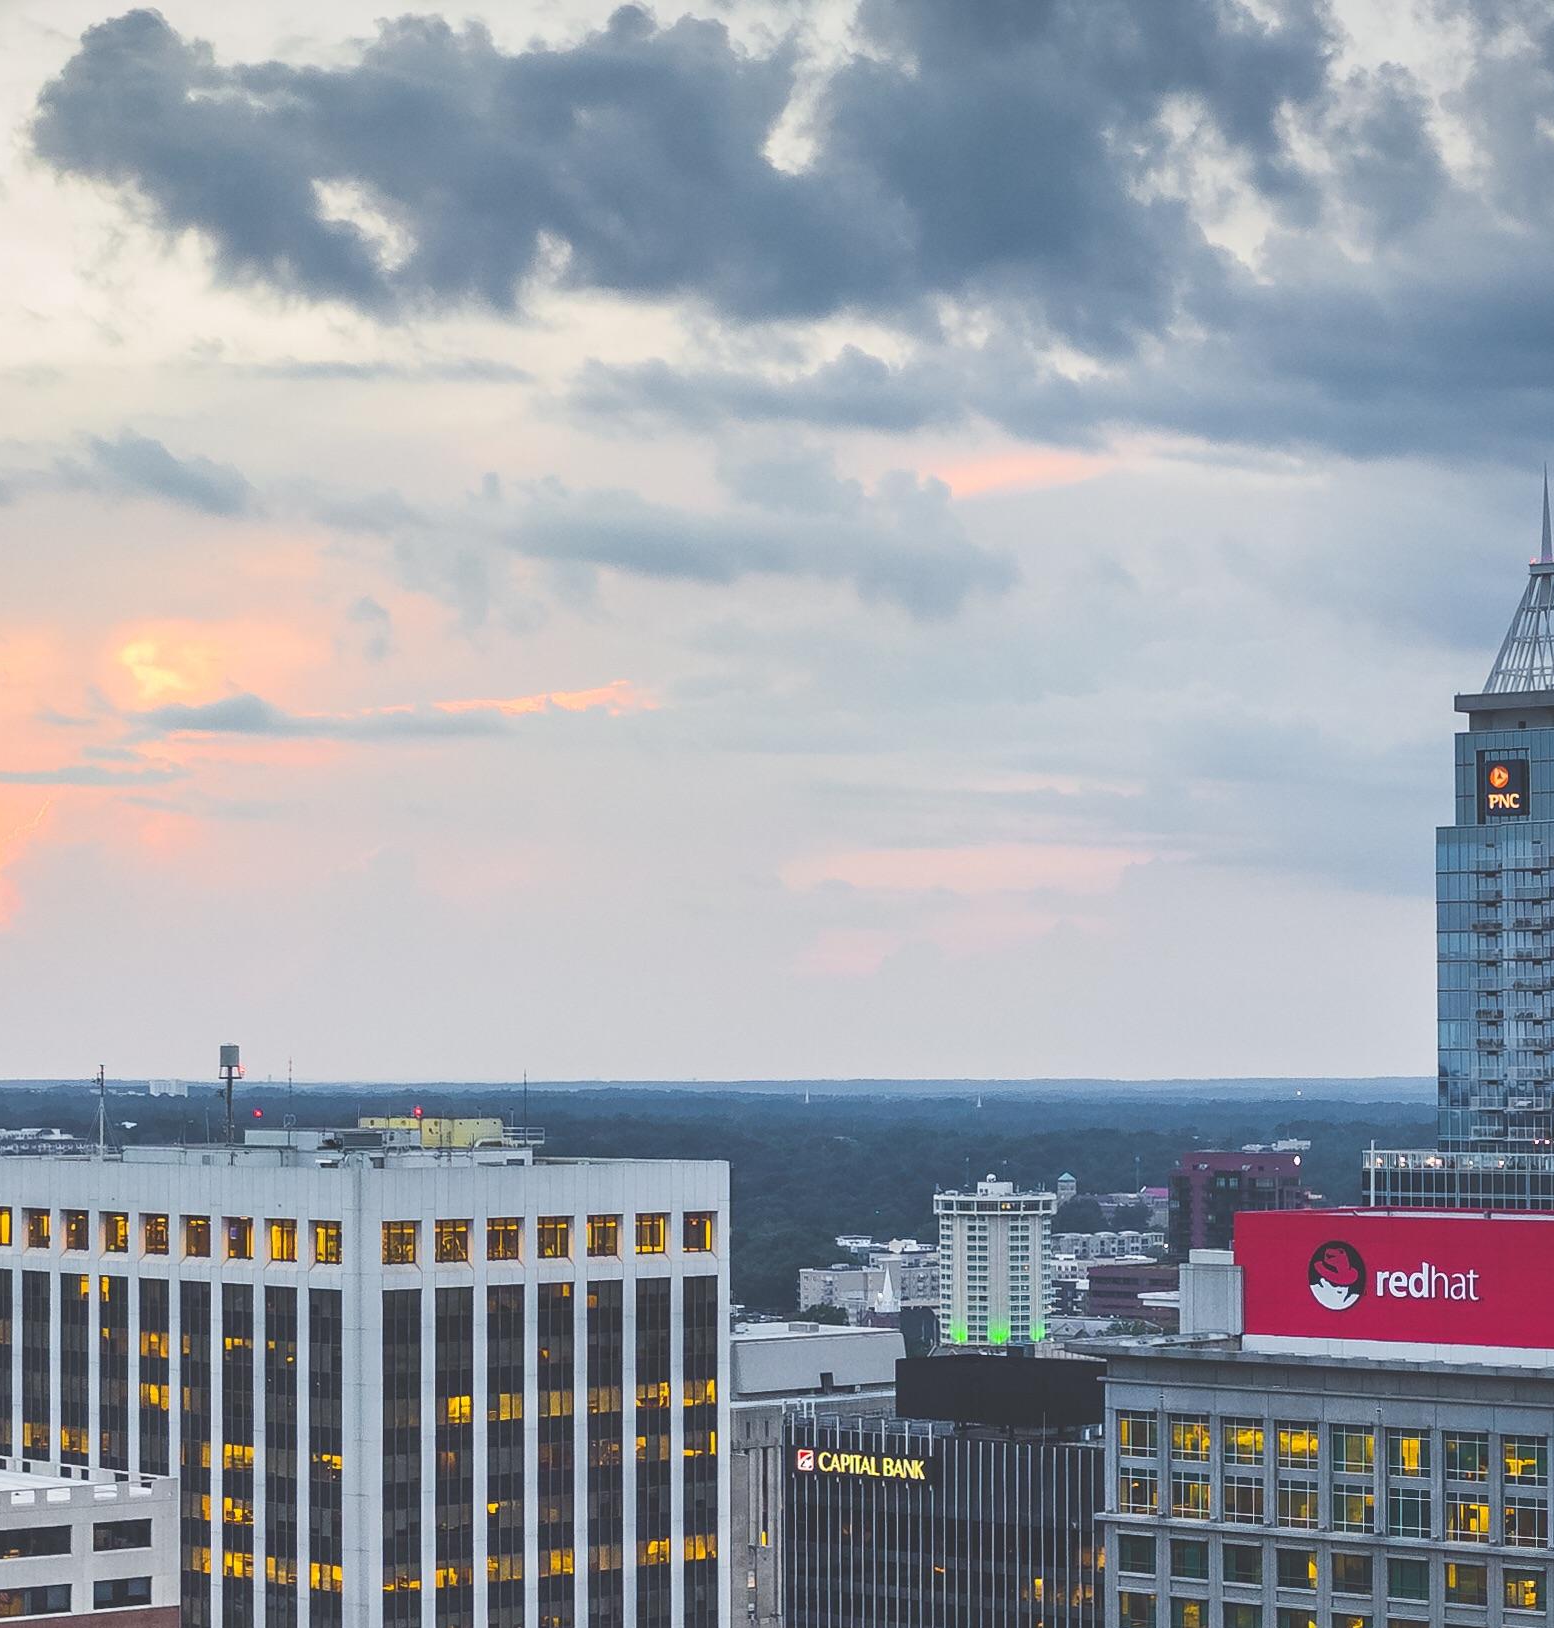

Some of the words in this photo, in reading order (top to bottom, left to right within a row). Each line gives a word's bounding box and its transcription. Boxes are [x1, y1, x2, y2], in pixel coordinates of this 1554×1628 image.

[1488, 792, 1520, 810] PNC
[1376, 1261, 1480, 1301] redhat
[818, 1451, 881, 1476] CAPITAL
[882, 1457, 926, 1480] BANK
